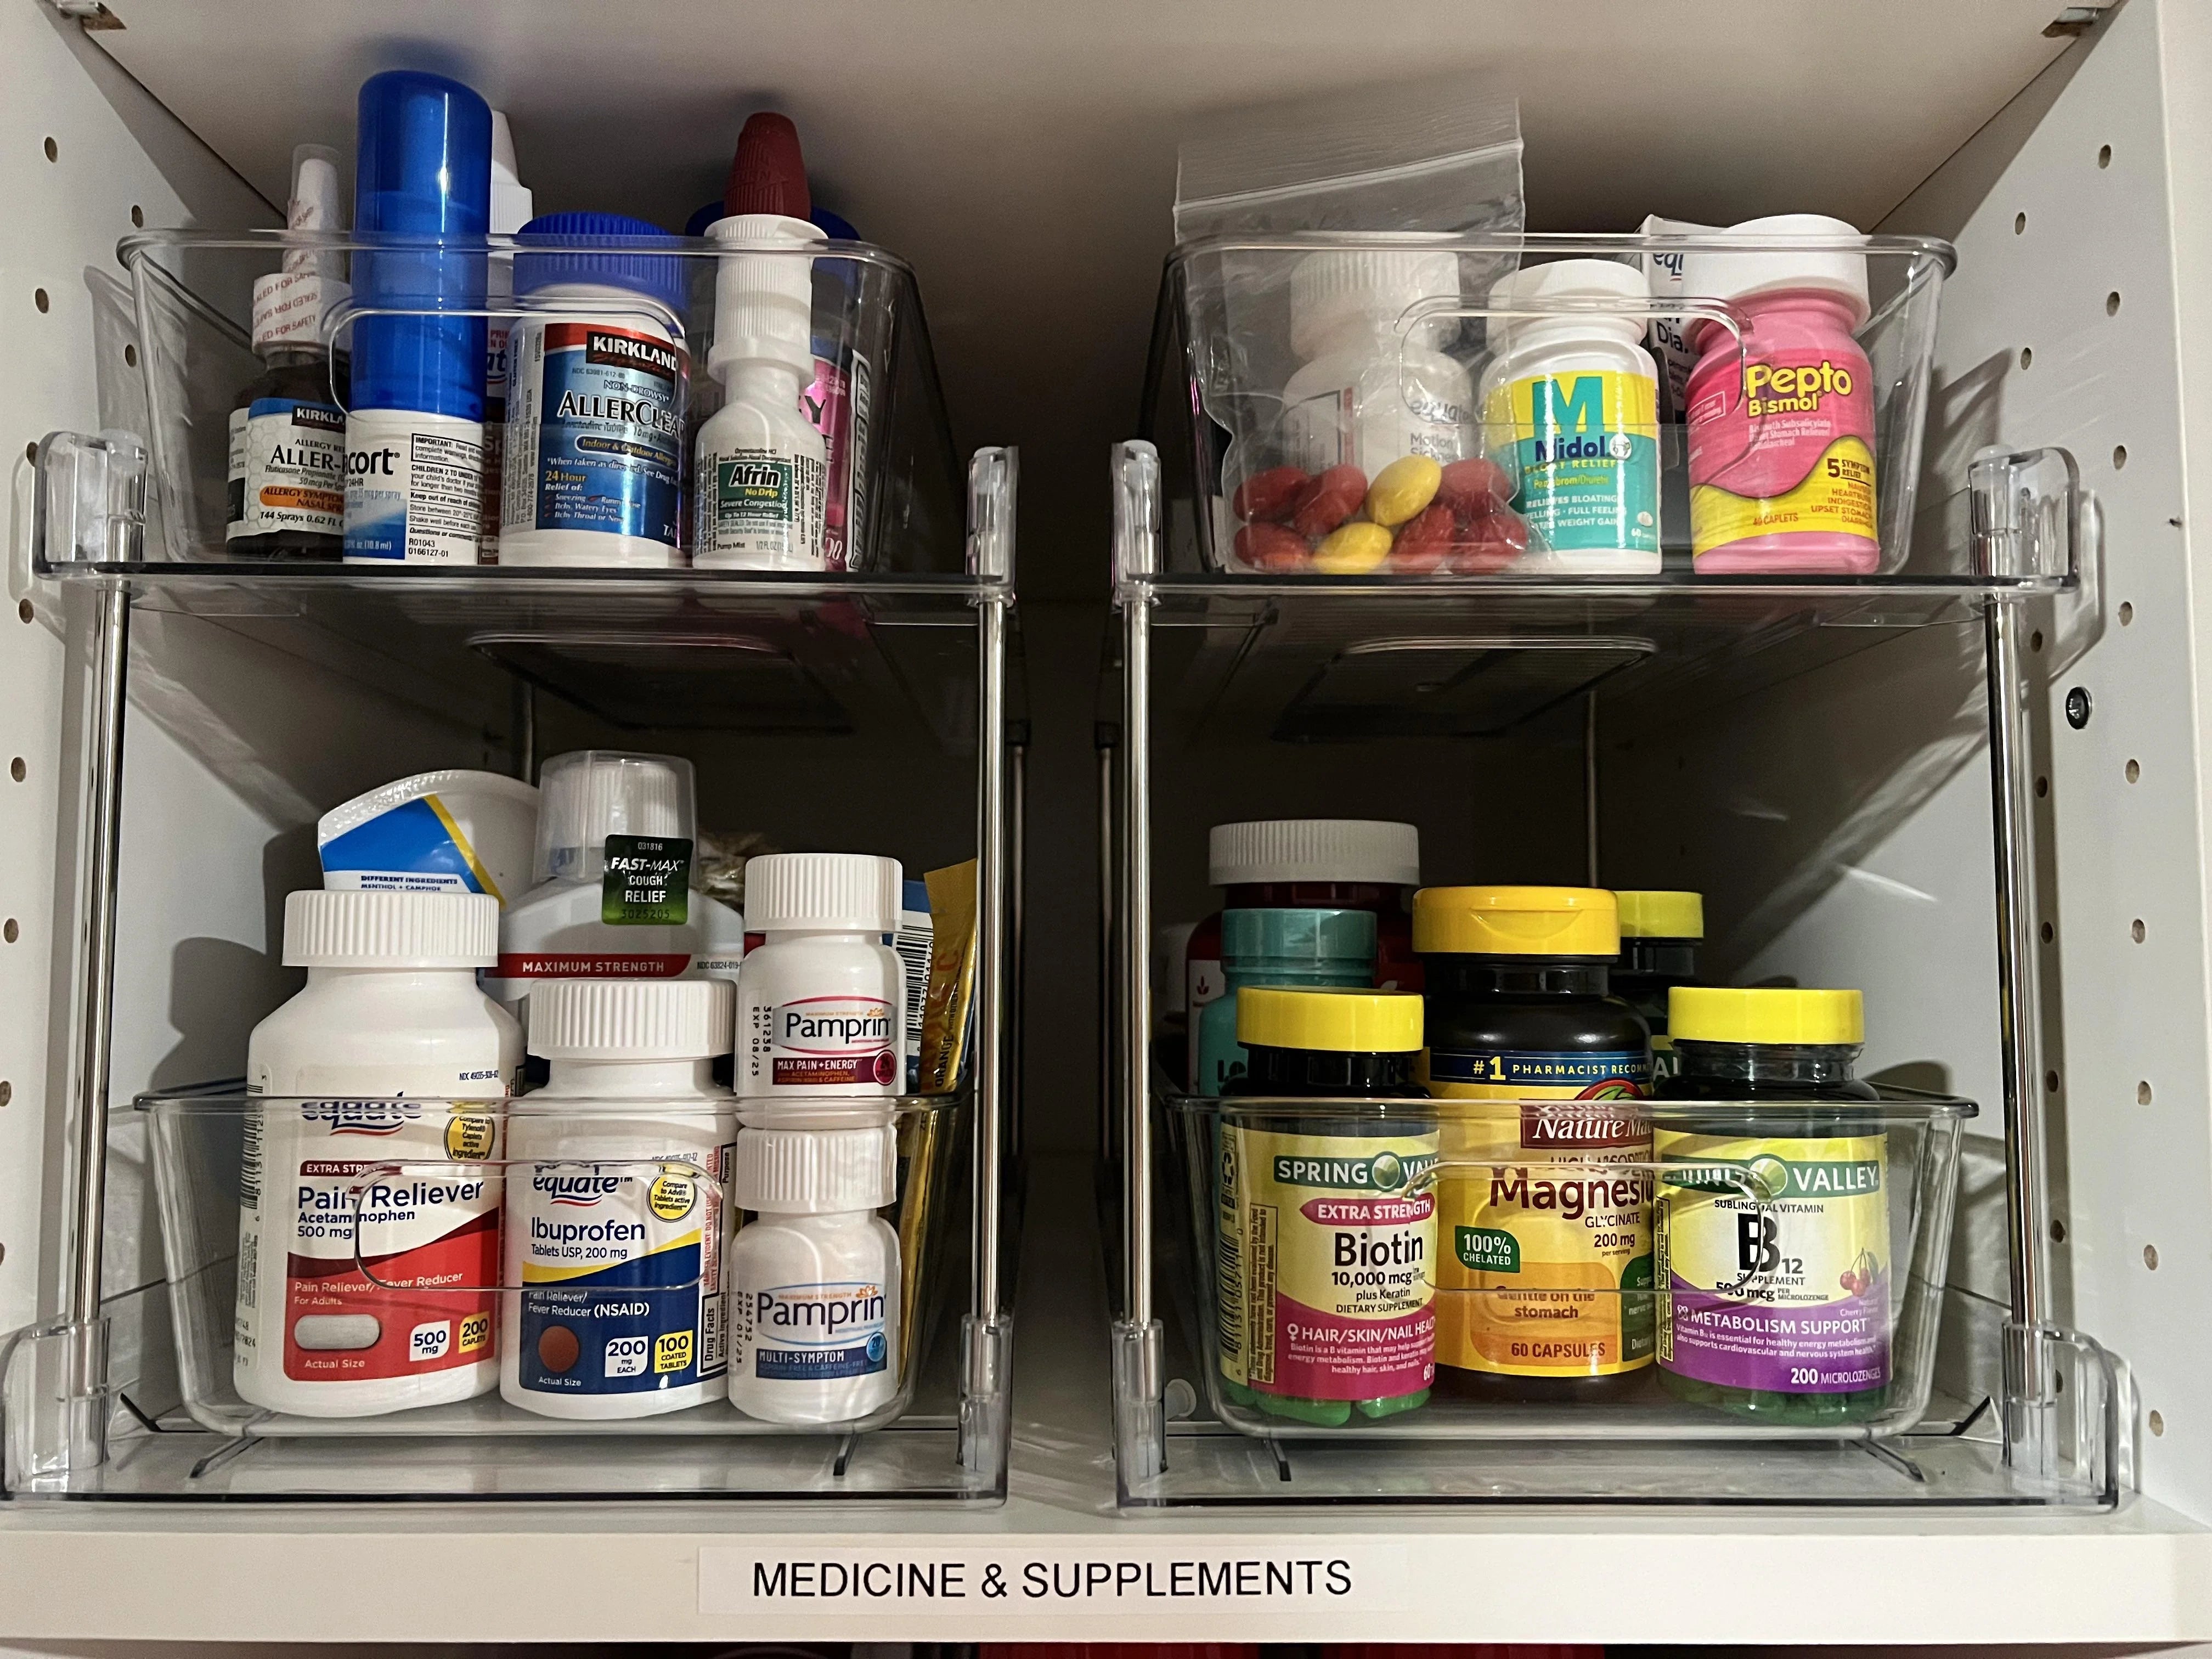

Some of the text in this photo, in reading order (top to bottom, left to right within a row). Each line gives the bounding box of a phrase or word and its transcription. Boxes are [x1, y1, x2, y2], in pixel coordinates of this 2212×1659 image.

[292, 314, 316, 330] SAFETY
[1746, 360, 1852, 398] Pepto
[1747, 396, 1819, 417] Bismol
[295, 439, 331, 450] ALLERGY
[582, 439, 610, 448] Indoor
[1410, 432, 1454, 449] Motion
[265, 465, 301, 475] Fluticasone
[411, 464, 443, 474] CHILDREN
[1572, 459, 1618, 468] RELIEF
[1827, 458, 1841, 478] 5
[545, 470, 586, 482] 24 Hour
[730, 465, 781, 488] Afrin
[264, 487, 303, 497] ALLERGY
[555, 494, 586, 503] Sneezing
[758, 488, 778, 498] Drip
[296, 499, 325, 509] NASAL
[720, 499, 743, 509] Severe
[1572, 495, 1618, 503] BLOATING
[427, 505, 452, 515] between
[575, 503, 600, 512] Watery
[1811, 505, 1839, 514] UPSET
[260, 511, 326, 524] 144 Sprays 0.62
[409, 515, 428, 524] Shake
[1558, 517, 1596, 527] WEIGHT
[1763, 513, 1798, 524] CAPLETS
[409, 528, 441, 537] Questions
[409, 538, 435, 548] R01043
[408, 548, 449, 557] 0166127-01
[637, 841, 663, 851] 031816
[611, 857, 681, 872] FAST-MAX
[361, 874, 404, 883] DIFFERENT
[629, 875, 663, 886] COUGH
[625, 890, 667, 903] RELIEF
[621, 908, 670, 919] 3025205
[522, 962, 664, 973] MAXIMUM STRENGTH
[697, 961, 710, 970] NDC
[786, 1012, 889, 1045] Pamprin
[777, 1060, 794, 1070] MAX
[935, 1034, 954, 1088] ORANGE
[1513, 1064, 1606, 1075] PHARMACIST
[1532, 1118, 1625, 1139] Nature
[306, 1164, 340, 1173] EXTRA
[722, 1152, 730, 1184] Purpose
[1278, 1159, 1368, 1184] SPRING
[662, 1181, 688, 1189] Compare
[1793, 1165, 1877, 1192] VALLEY
[371, 1181, 484, 1207] Reliever
[1318, 1198, 1431, 1220] EXTRA STRENGTH
[1781, 1204, 1824, 1213] VITAMIN
[1585, 1211, 1640, 1228] GLYCINATE
[297, 1226, 352, 1239] 500 mg
[531, 1217, 645, 1244] Ibuprofen
[1464, 1233, 1511, 1255] 100%
[1594, 1234, 1635, 1248] 200 mg
[531, 1244, 628, 1260] Tablets USP, 200 mg
[1334, 1230, 1423, 1267] Biotin
[1463, 1252, 1511, 1266] CHELATED
[294, 1273, 463, 1293] Pain Reliever/ Reducer
[1331, 1272, 1412, 1288] 10,000 mcg
[294, 1296, 342, 1306] For Adults
[1356, 1288, 1410, 1302] plus Keratin
[1747, 1288, 1775, 1302] mcg
[528, 1302, 650, 1318] Fever Reducer (NSAID)
[1336, 1298, 1423, 1313] DIETARY SUPPLEMENT
[1515, 1305, 1578, 1319] stomach
[745, 1293, 753, 1342] 254752
[757, 1292, 884, 1335] Pamprin
[462, 1318, 489, 1338] 200
[1234, 1306, 1243, 1350] 81131
[1691, 1309, 1867, 1334] METABOLISM SUPPORT
[414, 1330, 447, 1347] 500
[462, 1334, 487, 1347] CAPLETS
[704, 1307, 715, 1362] Drug Facts
[1302, 1324, 1414, 1344] HAIR/SKIN/NAIL
[1676, 1323, 1699, 1335] Vitamin
[1717, 1333, 1752, 1344] essential
[1753, 1336, 1764, 1345] for
[1766, 1338, 1797, 1349] healthy
[1799, 1341, 1826, 1349] energy
[421, 1345, 439, 1355] mg
[608, 1340, 646, 1357] 200
[658, 1335, 689, 1353] 100
[1290, 1343, 1314, 1352] Biotin
[1511, 1342, 1605, 1359] 60 CAPSULES
[1689, 1337, 1718, 1350] supports
[1719, 1344, 1778, 1356] cardiovascular
[1830, 1350, 1854, 1359] system
[661, 1352, 687, 1361] COATED
[759, 1351, 844, 1363] MULTI-SYMPTOM
[1288, 1354, 1387, 1363] energy metabolism. Biotin
[304, 1359, 365, 1368] Actual Size
[617, 1365, 636, 1374] EACH
[660, 1359, 687, 1370] TABLETS
[1331, 1365, 1361, 1375] healthy
[538, 1376, 582, 1386] Actual Size
[1791, 1368, 1819, 1384] 200
[753, 1559, 1353, 1599] MEDICINE & SUPPLEMENTS
